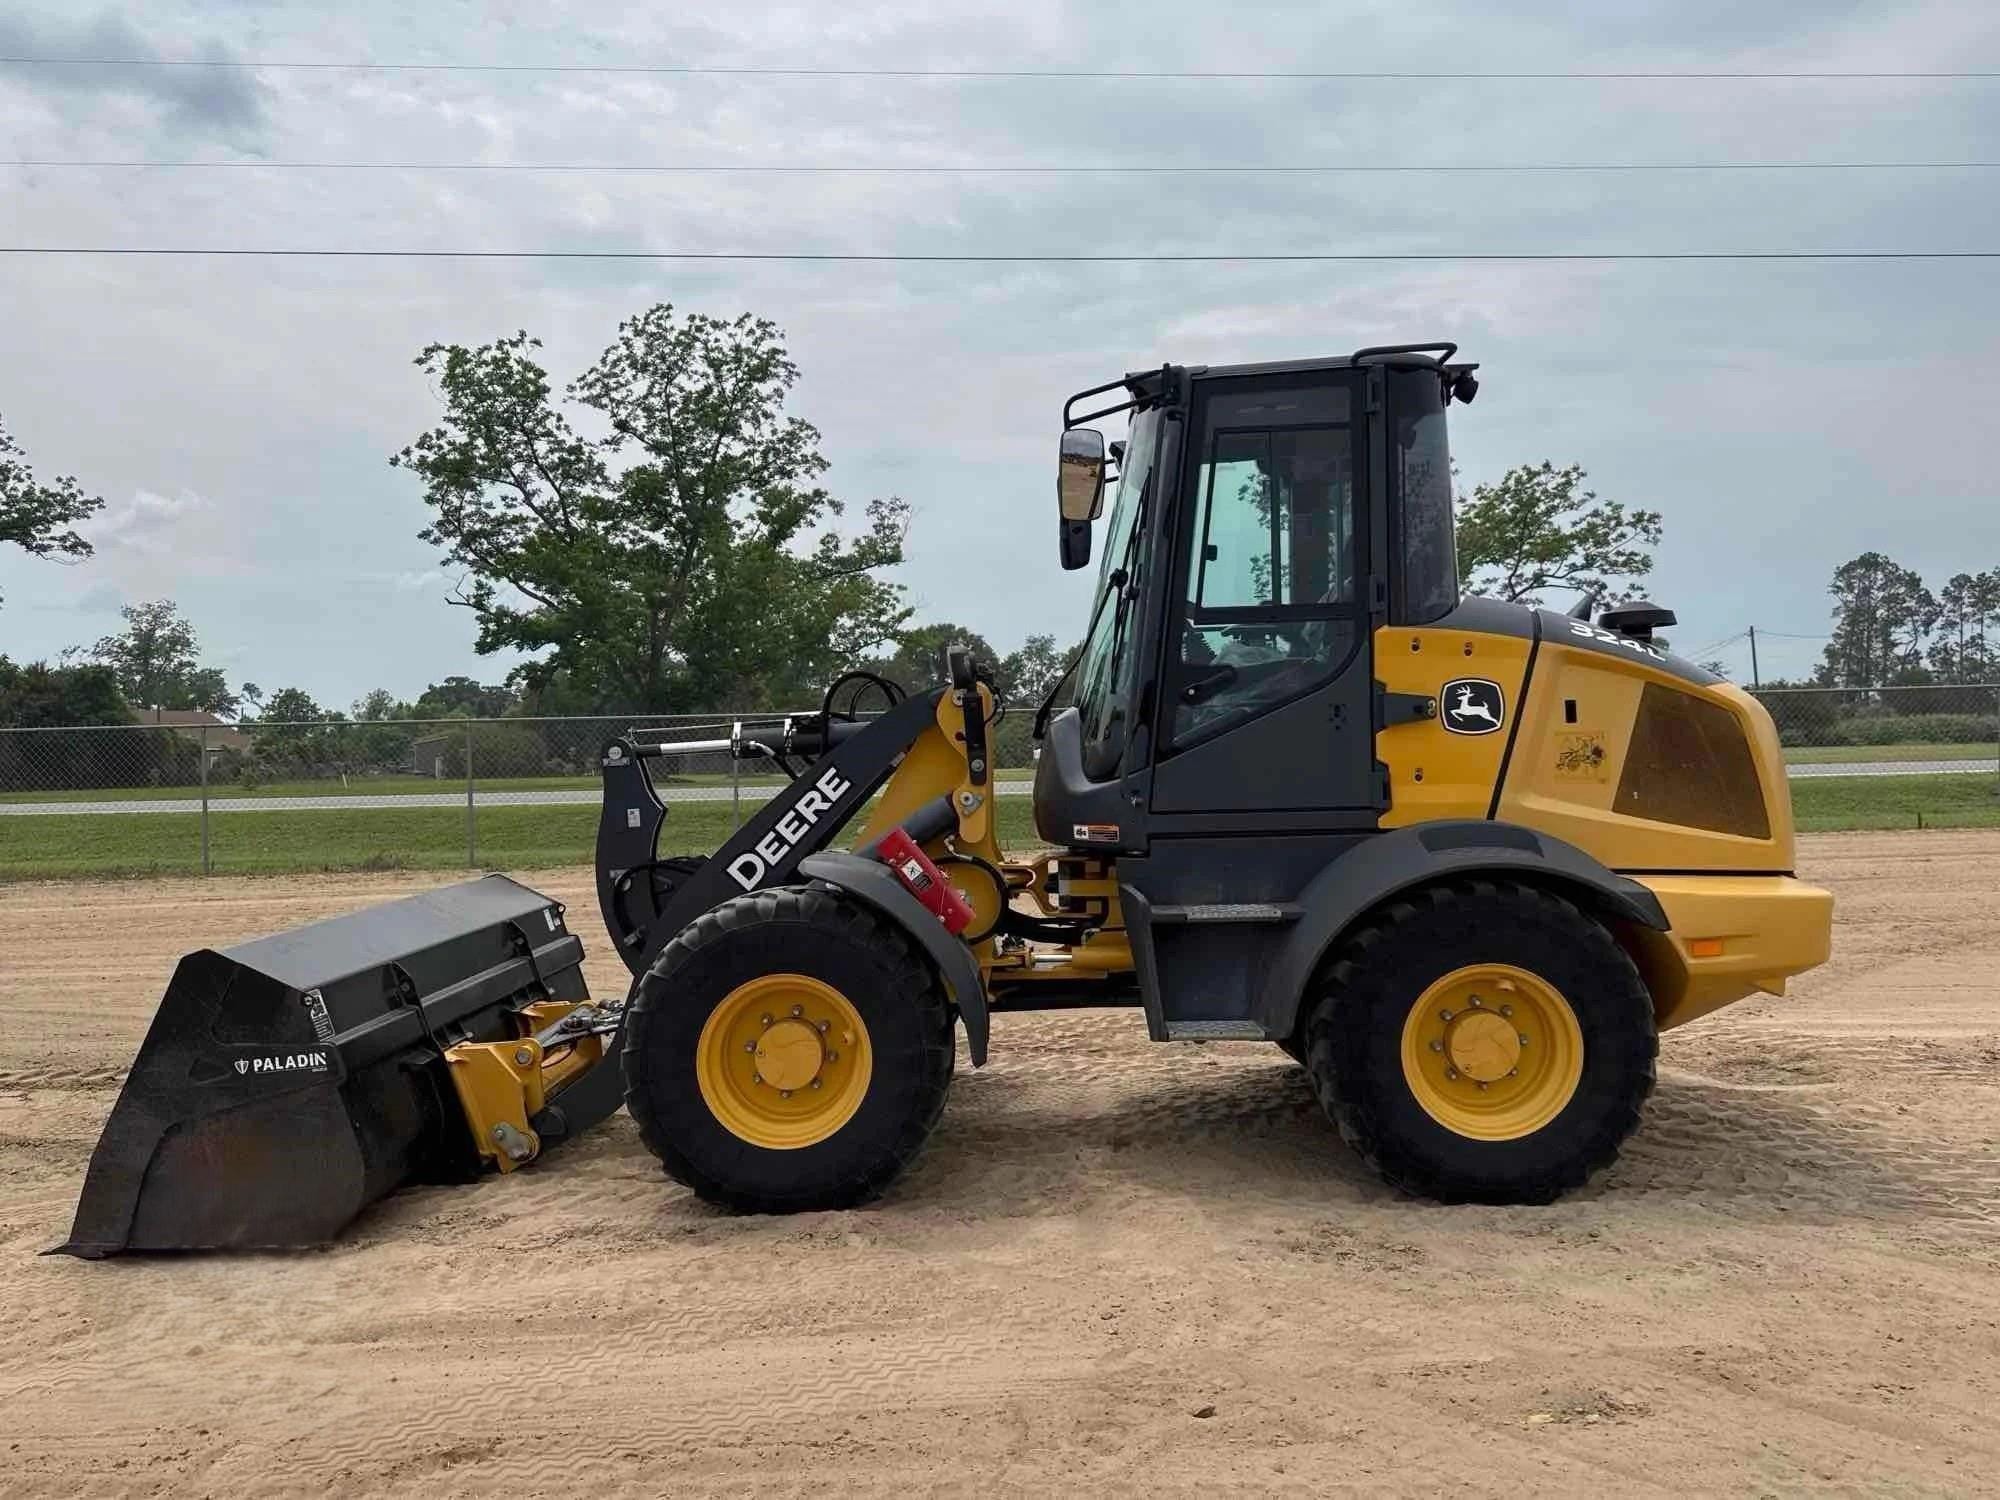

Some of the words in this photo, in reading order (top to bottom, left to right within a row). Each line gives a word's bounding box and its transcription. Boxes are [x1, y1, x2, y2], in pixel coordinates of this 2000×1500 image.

[1569, 622, 1666, 662] 324L
[726, 766, 851, 892] DEERE
[253, 1052, 327, 1073] PALADIN
